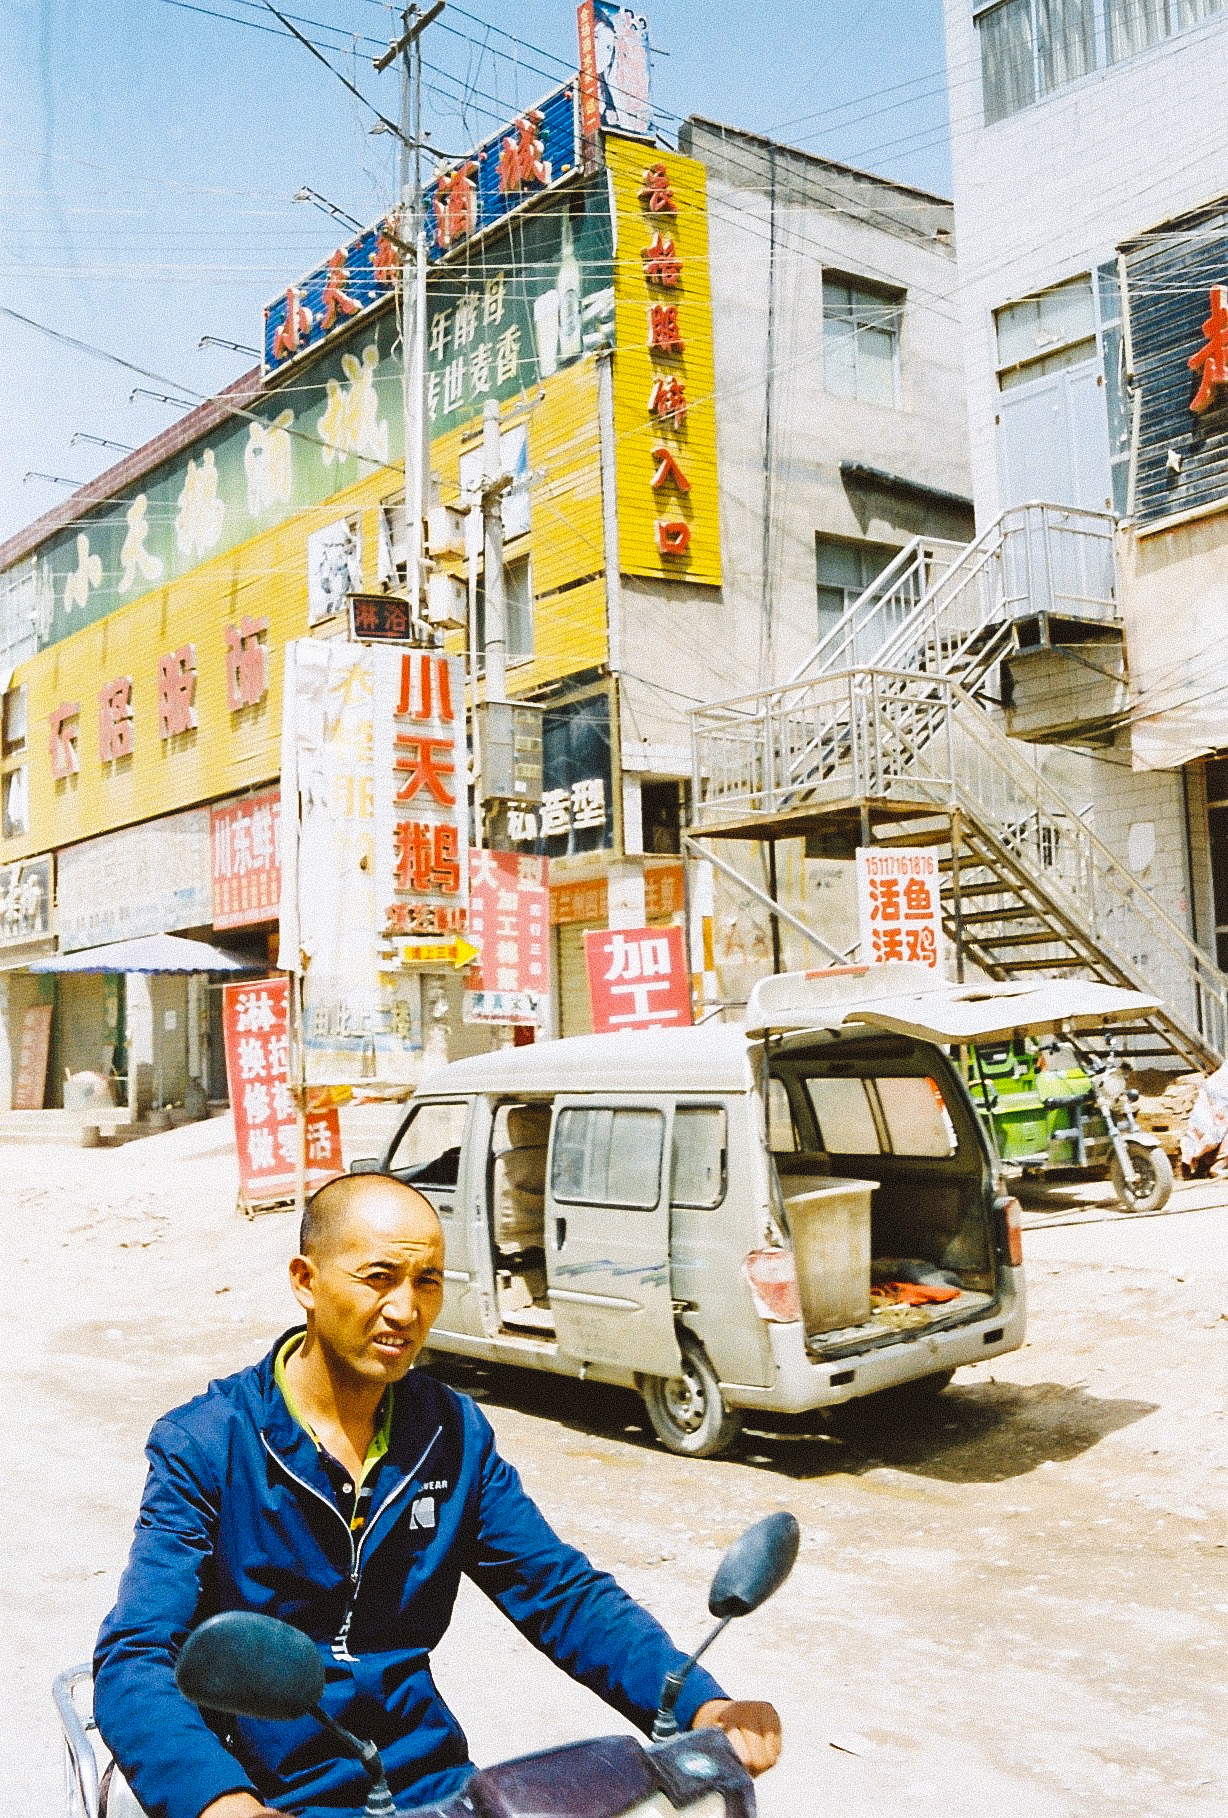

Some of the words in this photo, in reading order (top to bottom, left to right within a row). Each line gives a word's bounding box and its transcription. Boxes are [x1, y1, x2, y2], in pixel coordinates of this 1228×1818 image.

[394, 654, 460, 894] 小天鹅
[869, 878, 934, 921] 活鱼
[872, 926, 937, 968] 活鸡
[603, 933, 680, 1031] 加工
[418, 1480, 448, 1492] WEAR
